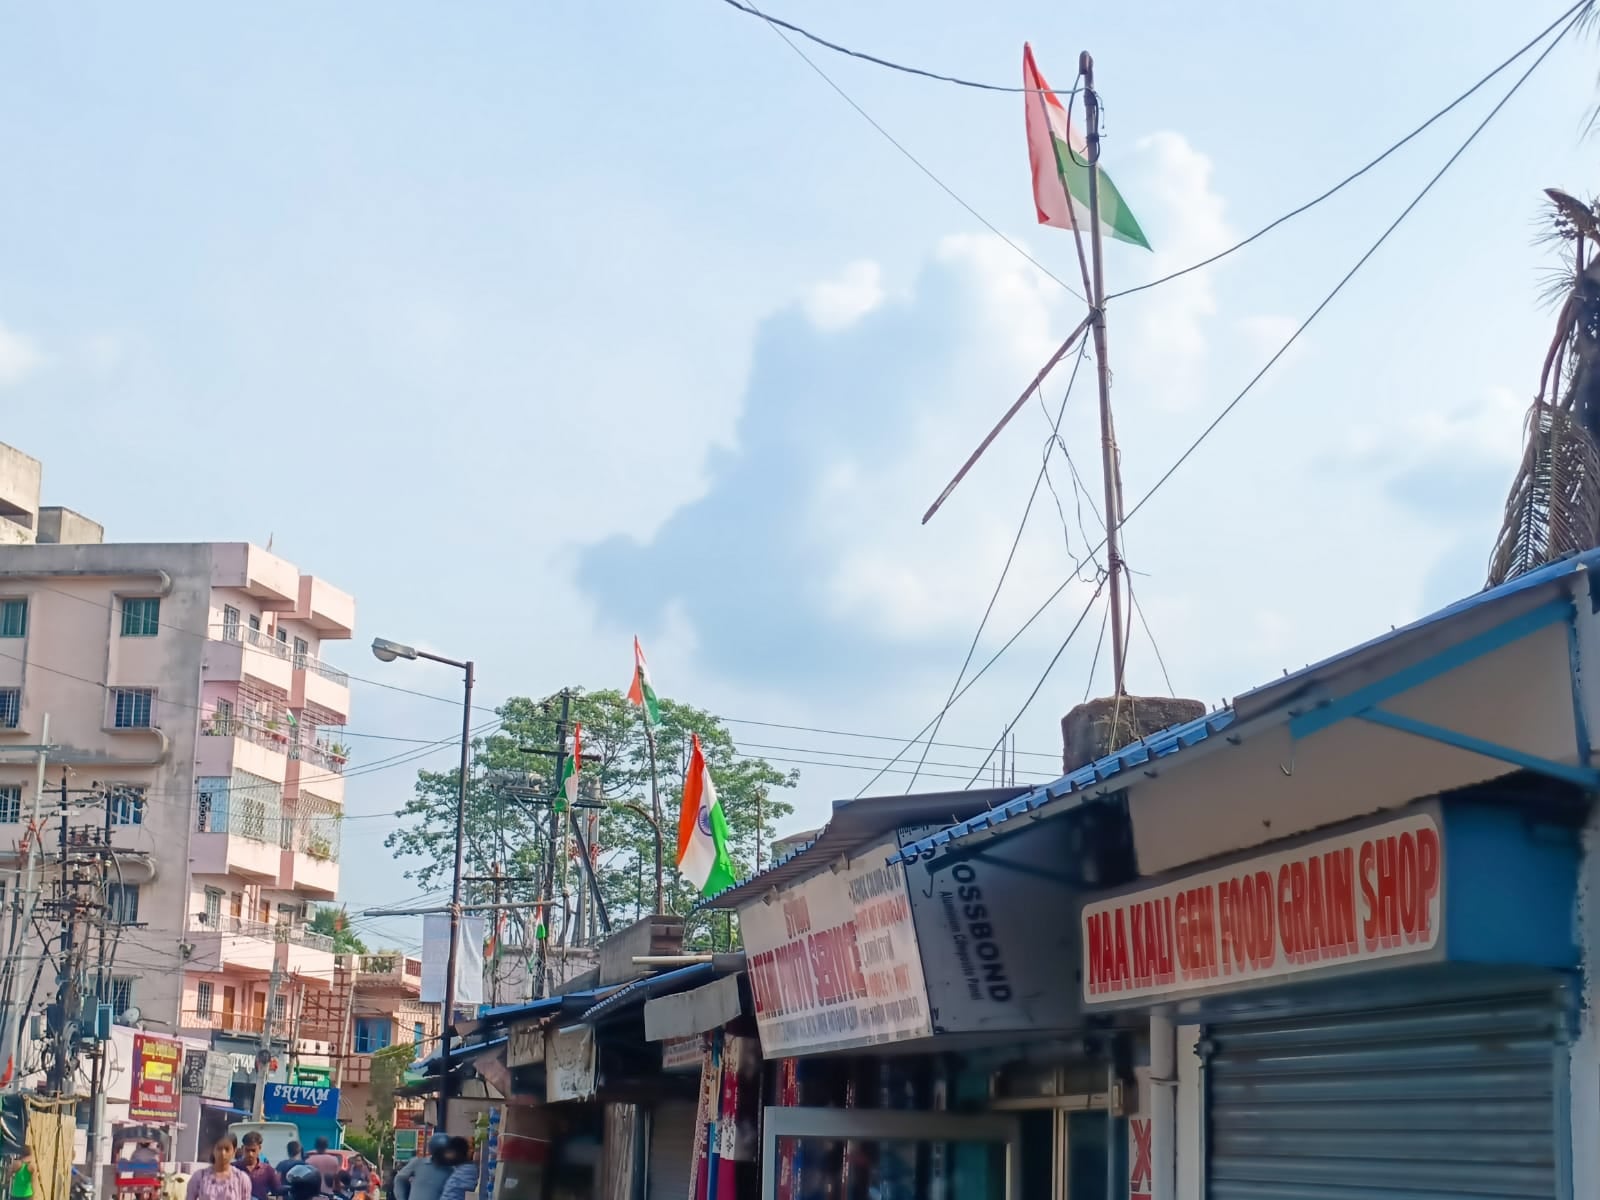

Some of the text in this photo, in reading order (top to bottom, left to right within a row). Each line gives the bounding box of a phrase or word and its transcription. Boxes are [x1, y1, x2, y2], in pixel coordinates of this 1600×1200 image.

[952, 864, 1012, 1002] OSSBOND
[1088, 908, 1132, 995] MAA
[1130, 896, 1176, 988] KALI
[1218, 871, 1276, 975] FOOD
[1278, 847, 1359, 964] GRAIN
[1359, 828, 1439, 952] SHOP
[229, 1053, 256, 1074] IVAM
[273, 1085, 330, 1106] SHIVAM
